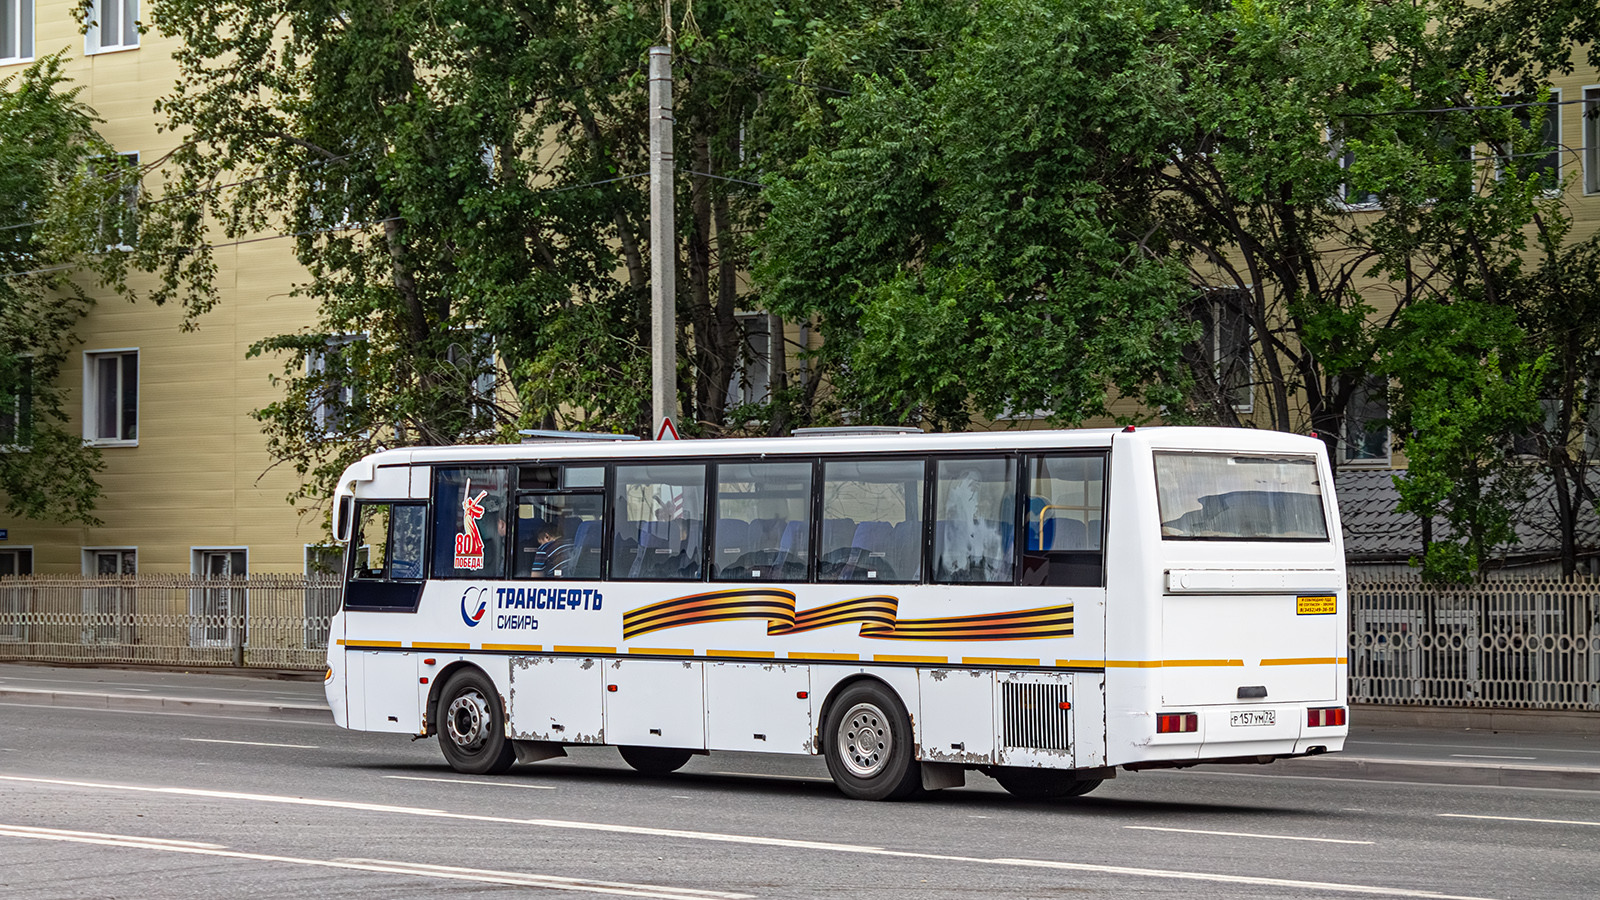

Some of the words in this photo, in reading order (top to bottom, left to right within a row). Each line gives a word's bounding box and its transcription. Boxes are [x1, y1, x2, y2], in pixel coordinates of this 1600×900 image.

[456, 534, 471, 554] 80
[455, 558, 483, 569] ПОБЕДА!
[496, 587, 603, 611] ТРАНСНЕФТЬ
[497, 615, 539, 630] СИБИРЬ
